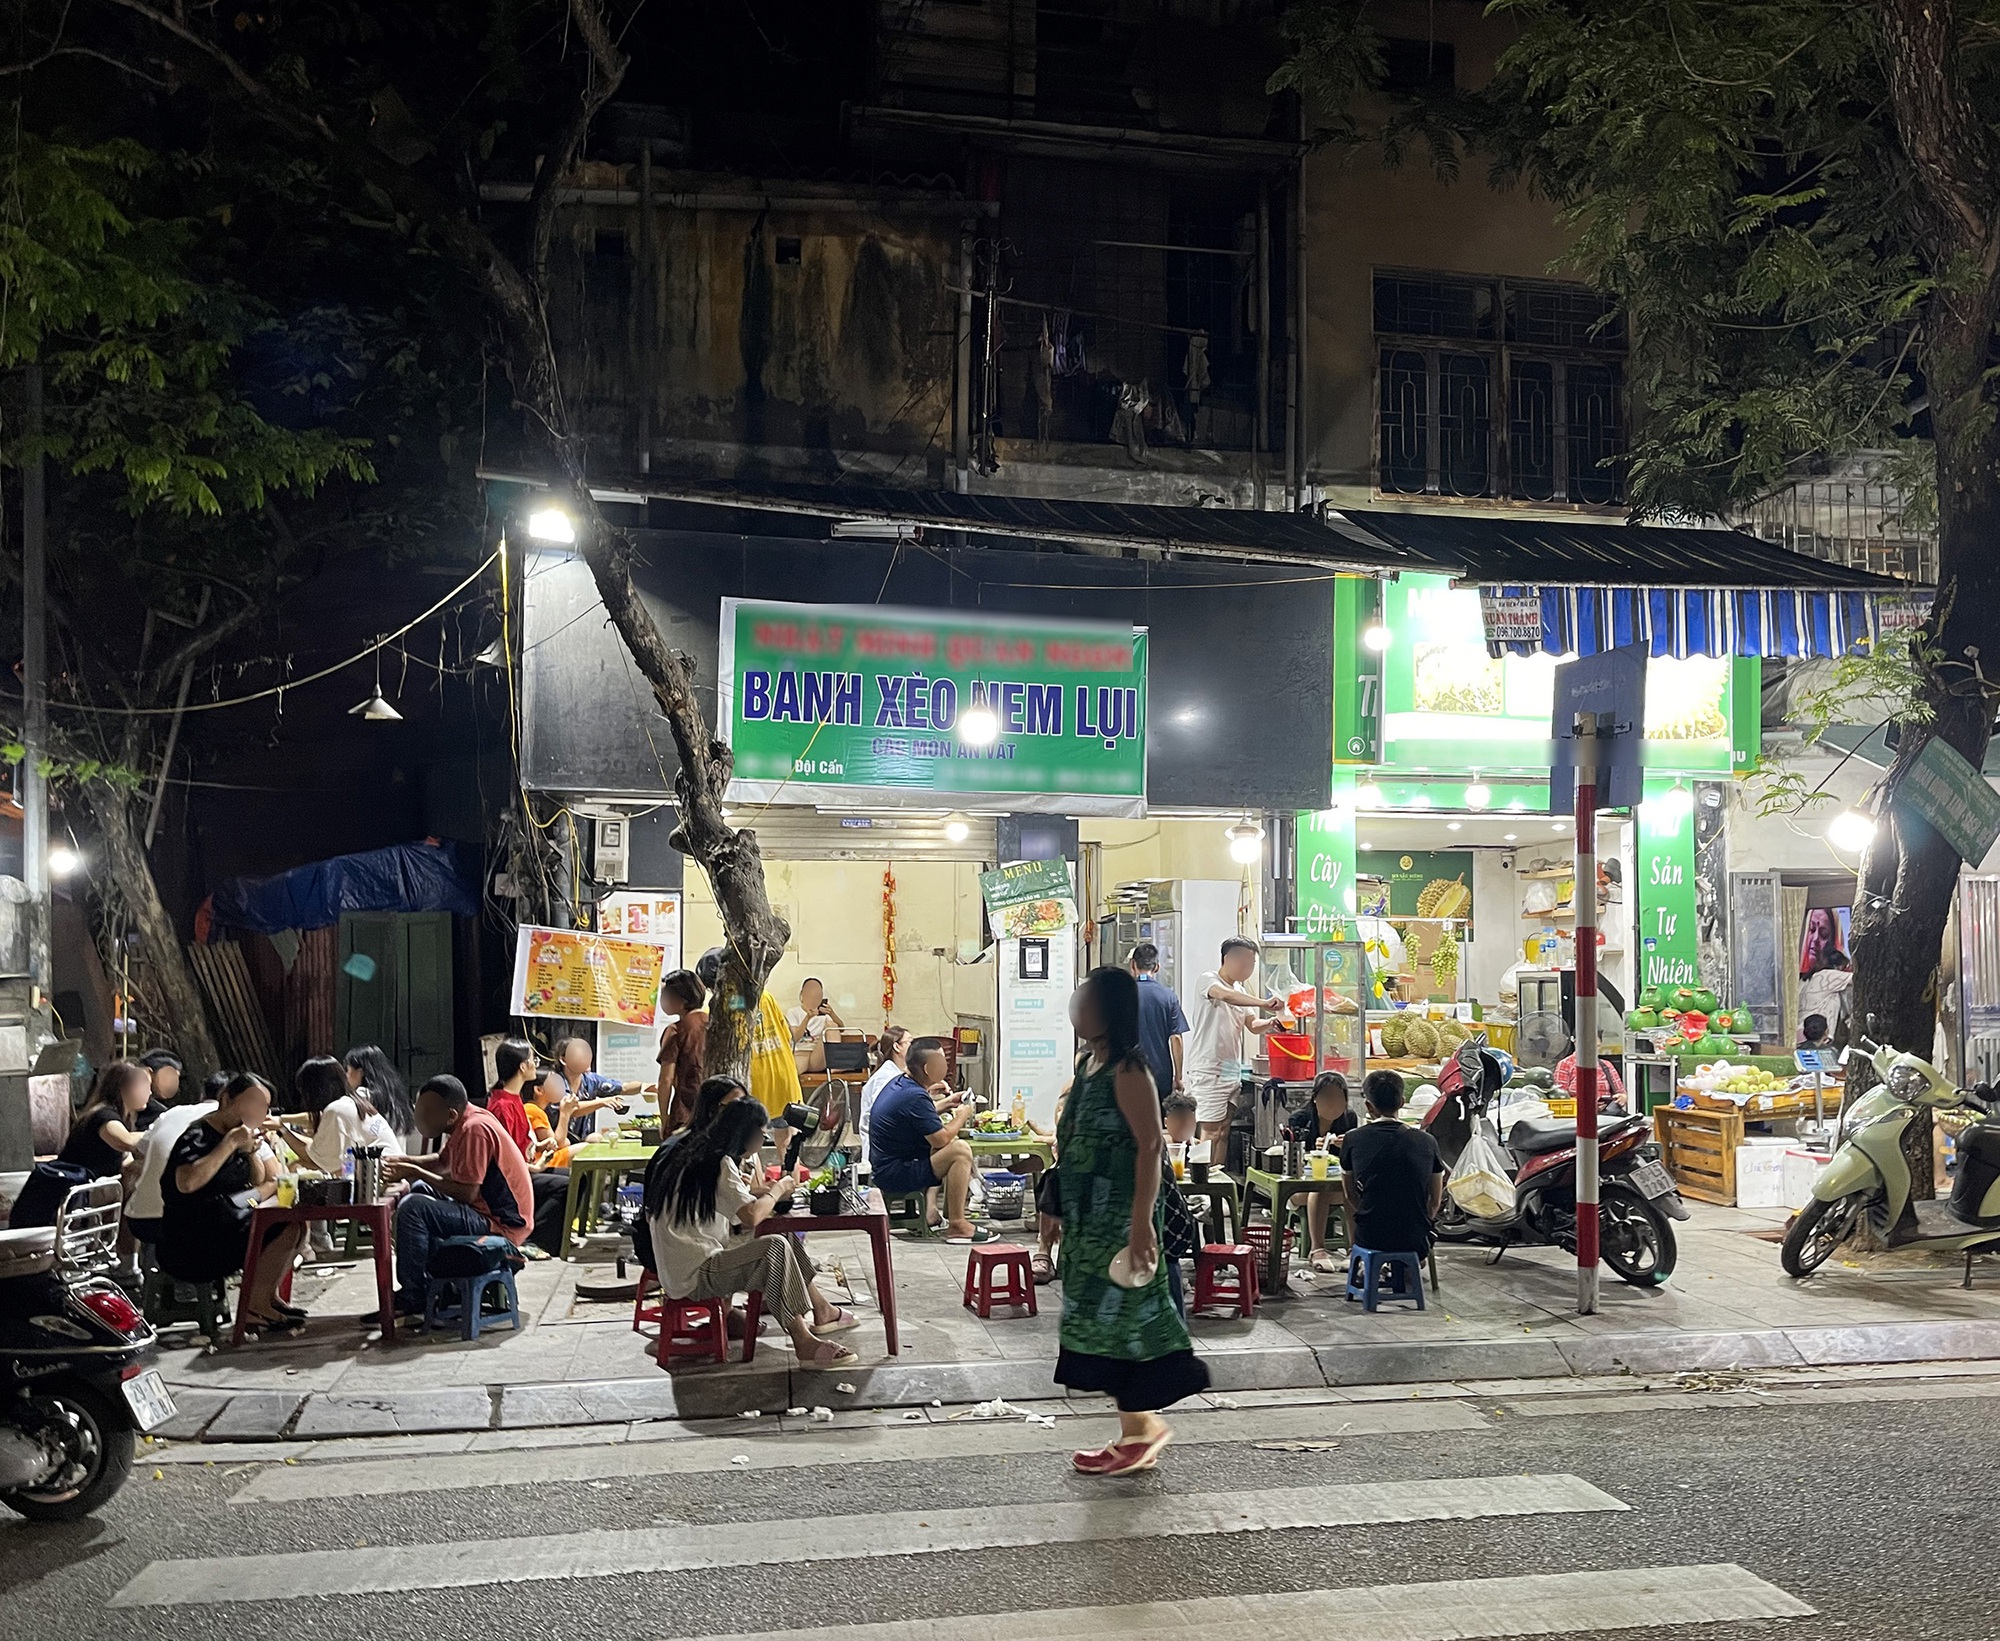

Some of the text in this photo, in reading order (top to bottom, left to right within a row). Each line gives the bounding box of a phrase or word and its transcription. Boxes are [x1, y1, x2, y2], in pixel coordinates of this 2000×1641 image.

[1076, 686, 1137, 750] LỤI
[795, 760, 815, 776] Đội
[819, 760, 844, 775] Cấn
[1003, 861, 1043, 880] MENU
[1310, 853, 1342, 889] Cây
[1656, 907, 1677, 941] Tự
[1647, 956, 1694, 984] Nhiên
